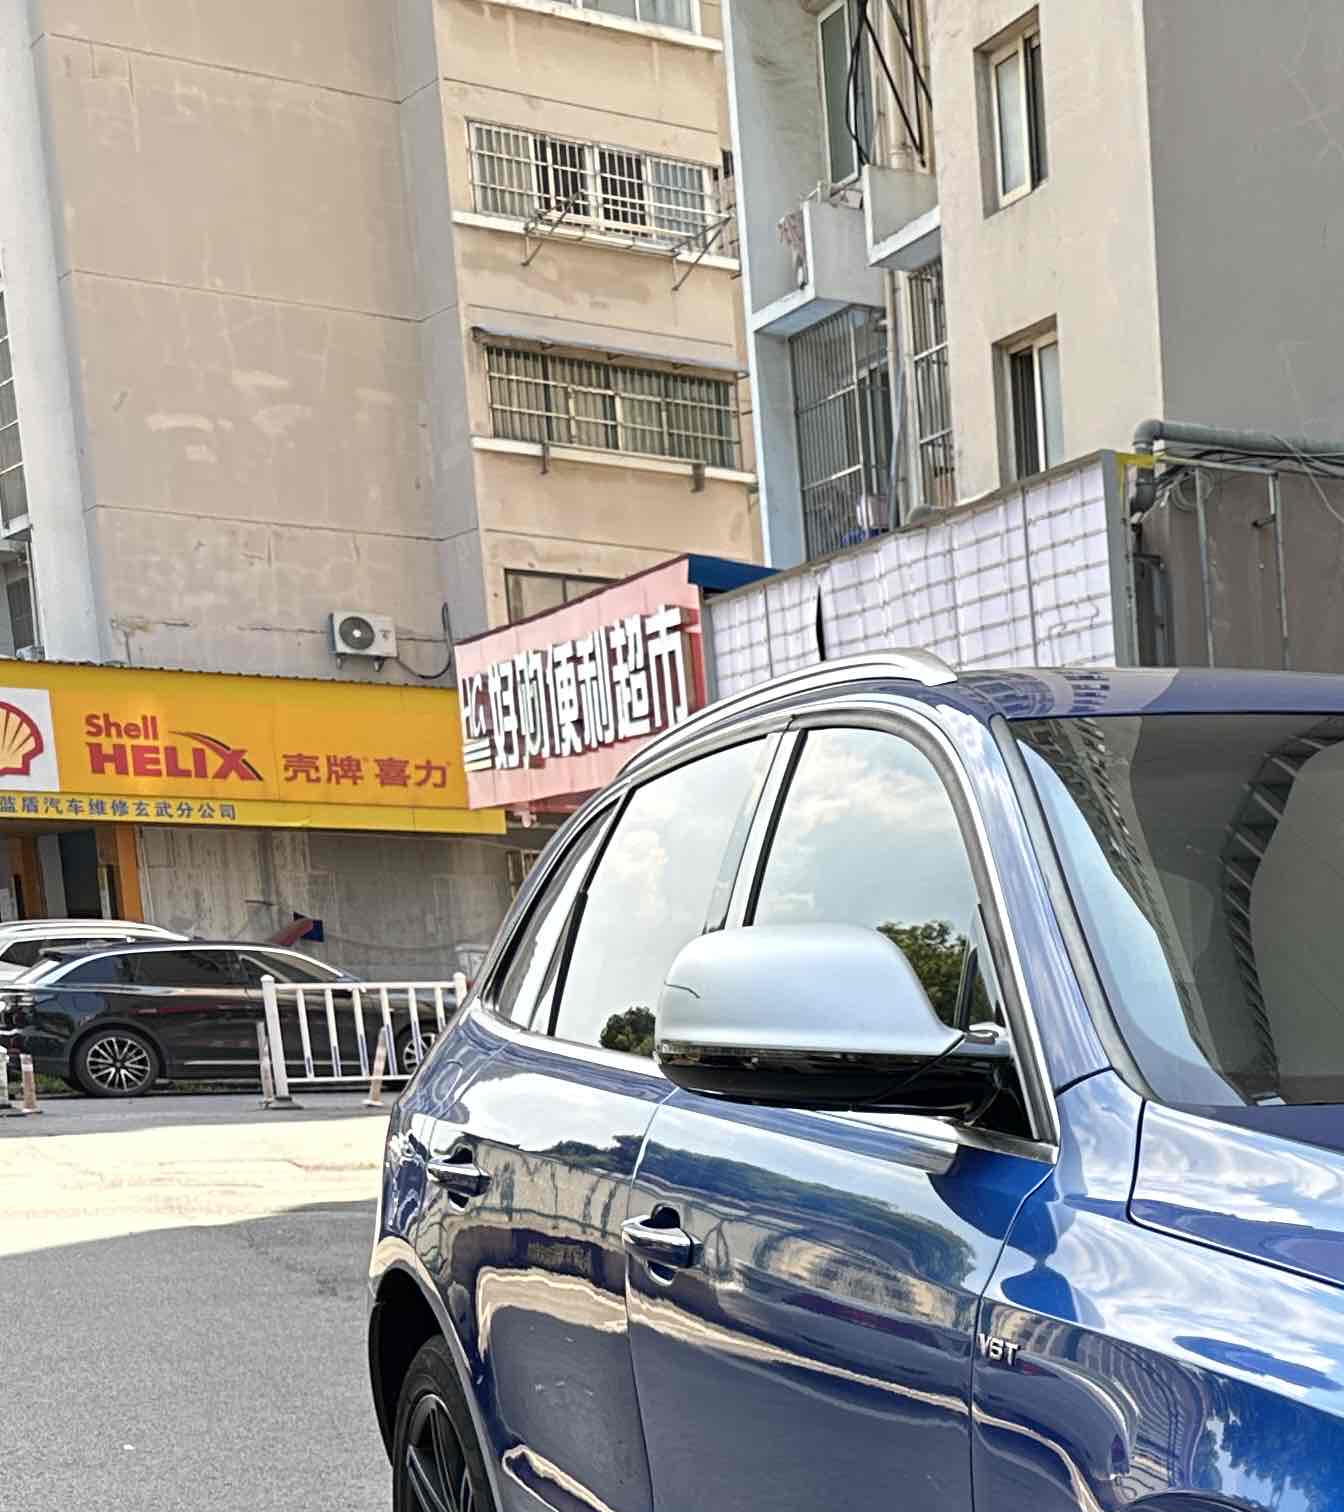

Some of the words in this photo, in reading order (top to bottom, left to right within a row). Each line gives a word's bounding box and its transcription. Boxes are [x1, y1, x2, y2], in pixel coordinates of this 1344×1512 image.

[487, 604, 690, 770] 好购便利超市
[84, 712, 159, 740] Shell
[86, 741, 258, 782] HELIX
[976, 1332, 1022, 1367] V6T
